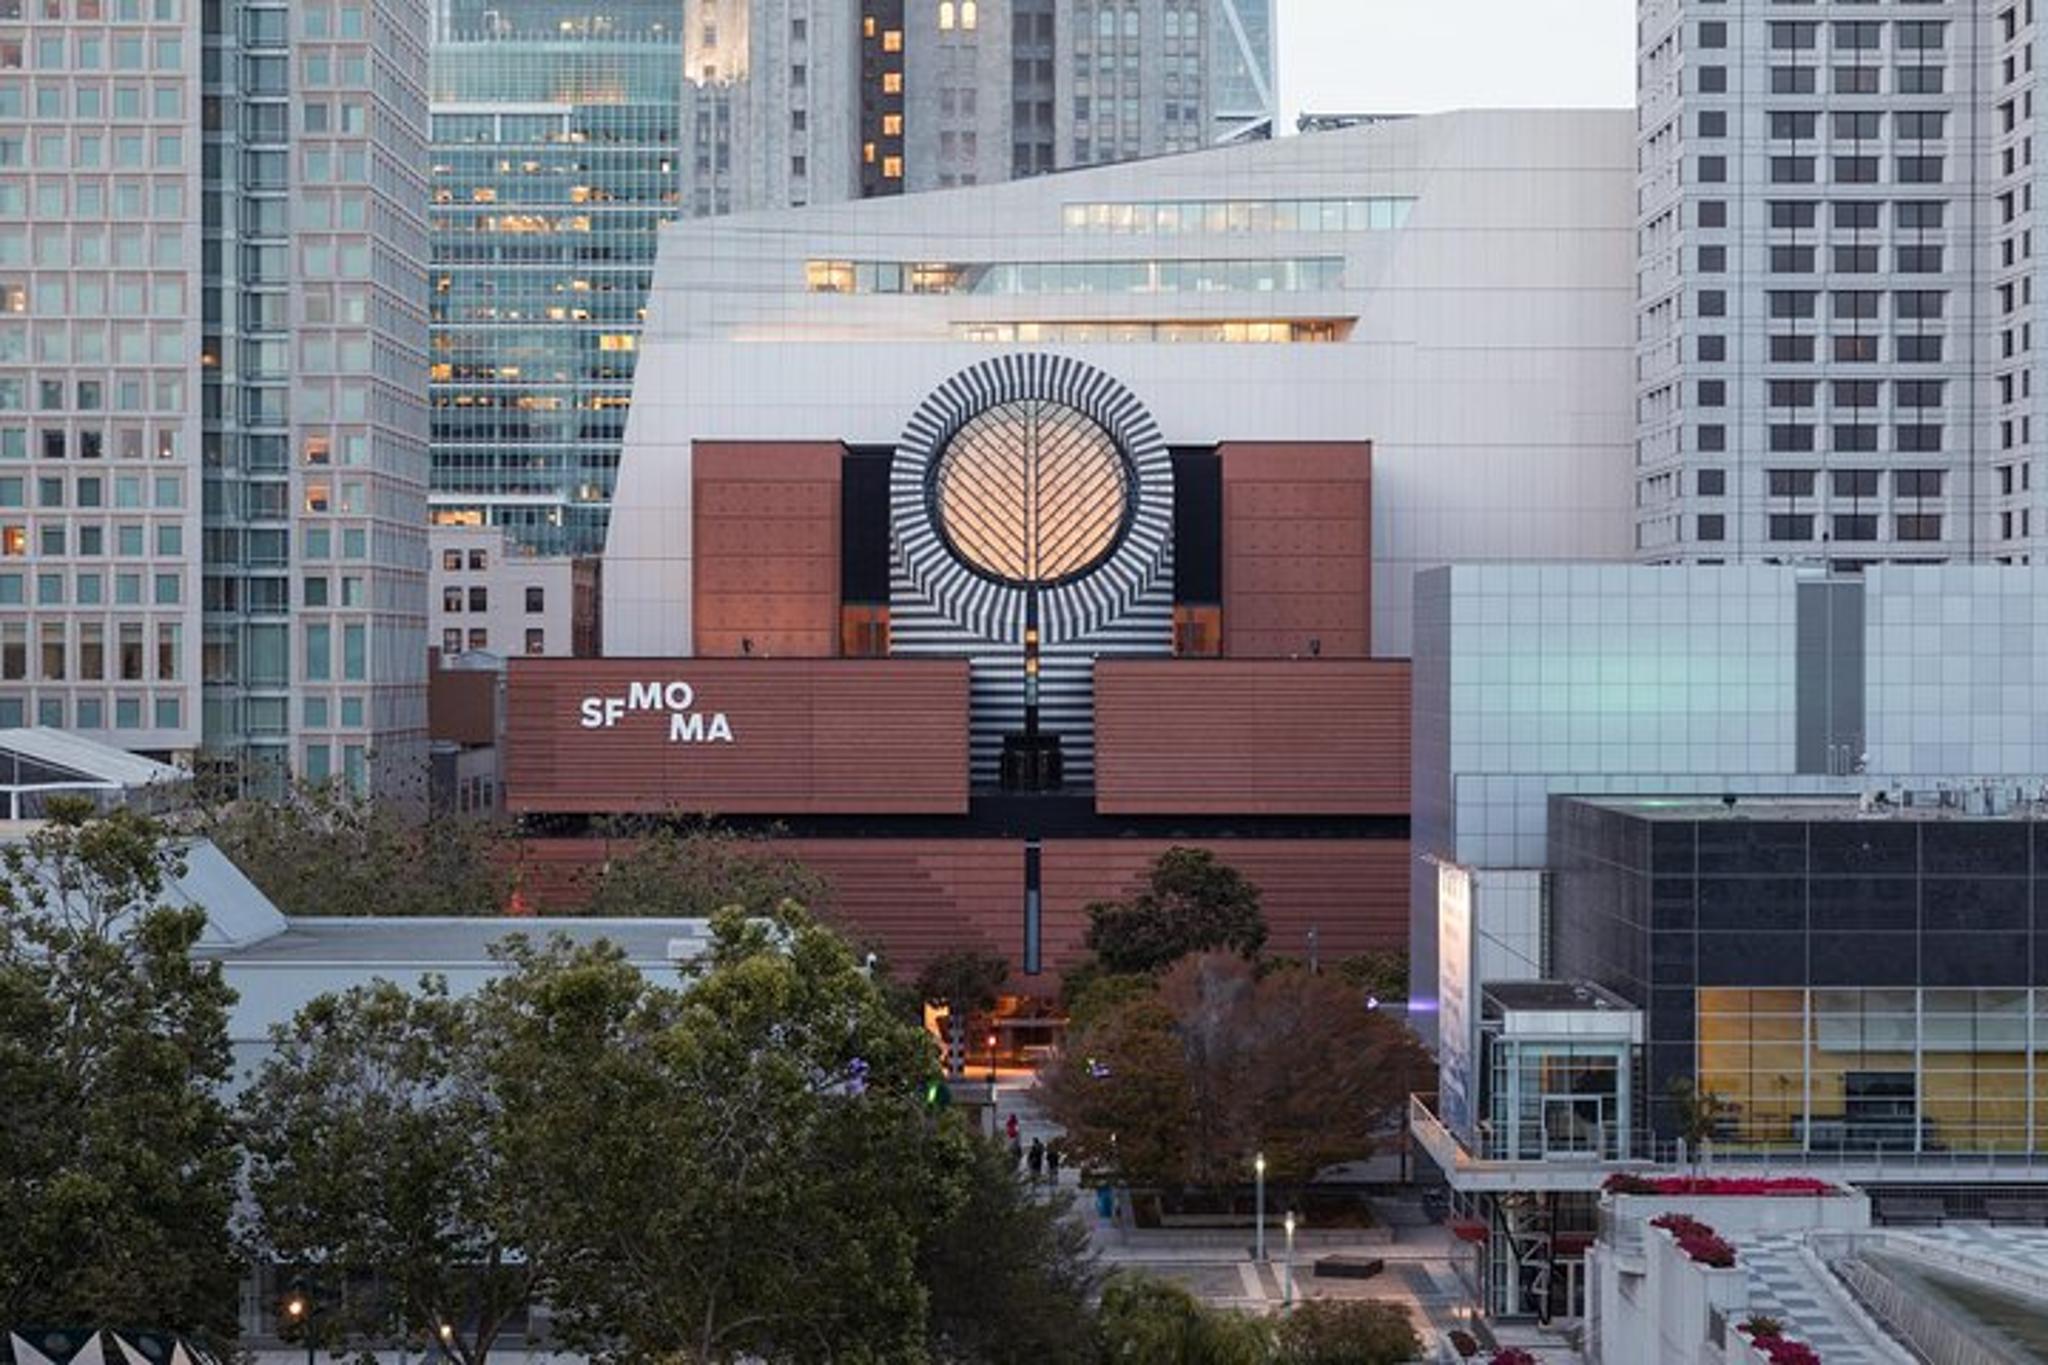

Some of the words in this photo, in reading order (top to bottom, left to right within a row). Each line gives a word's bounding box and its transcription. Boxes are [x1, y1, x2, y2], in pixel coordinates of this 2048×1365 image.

[629, 681, 693, 709] MO
[581, 697, 625, 728] SF
[670, 713, 733, 742] MA
